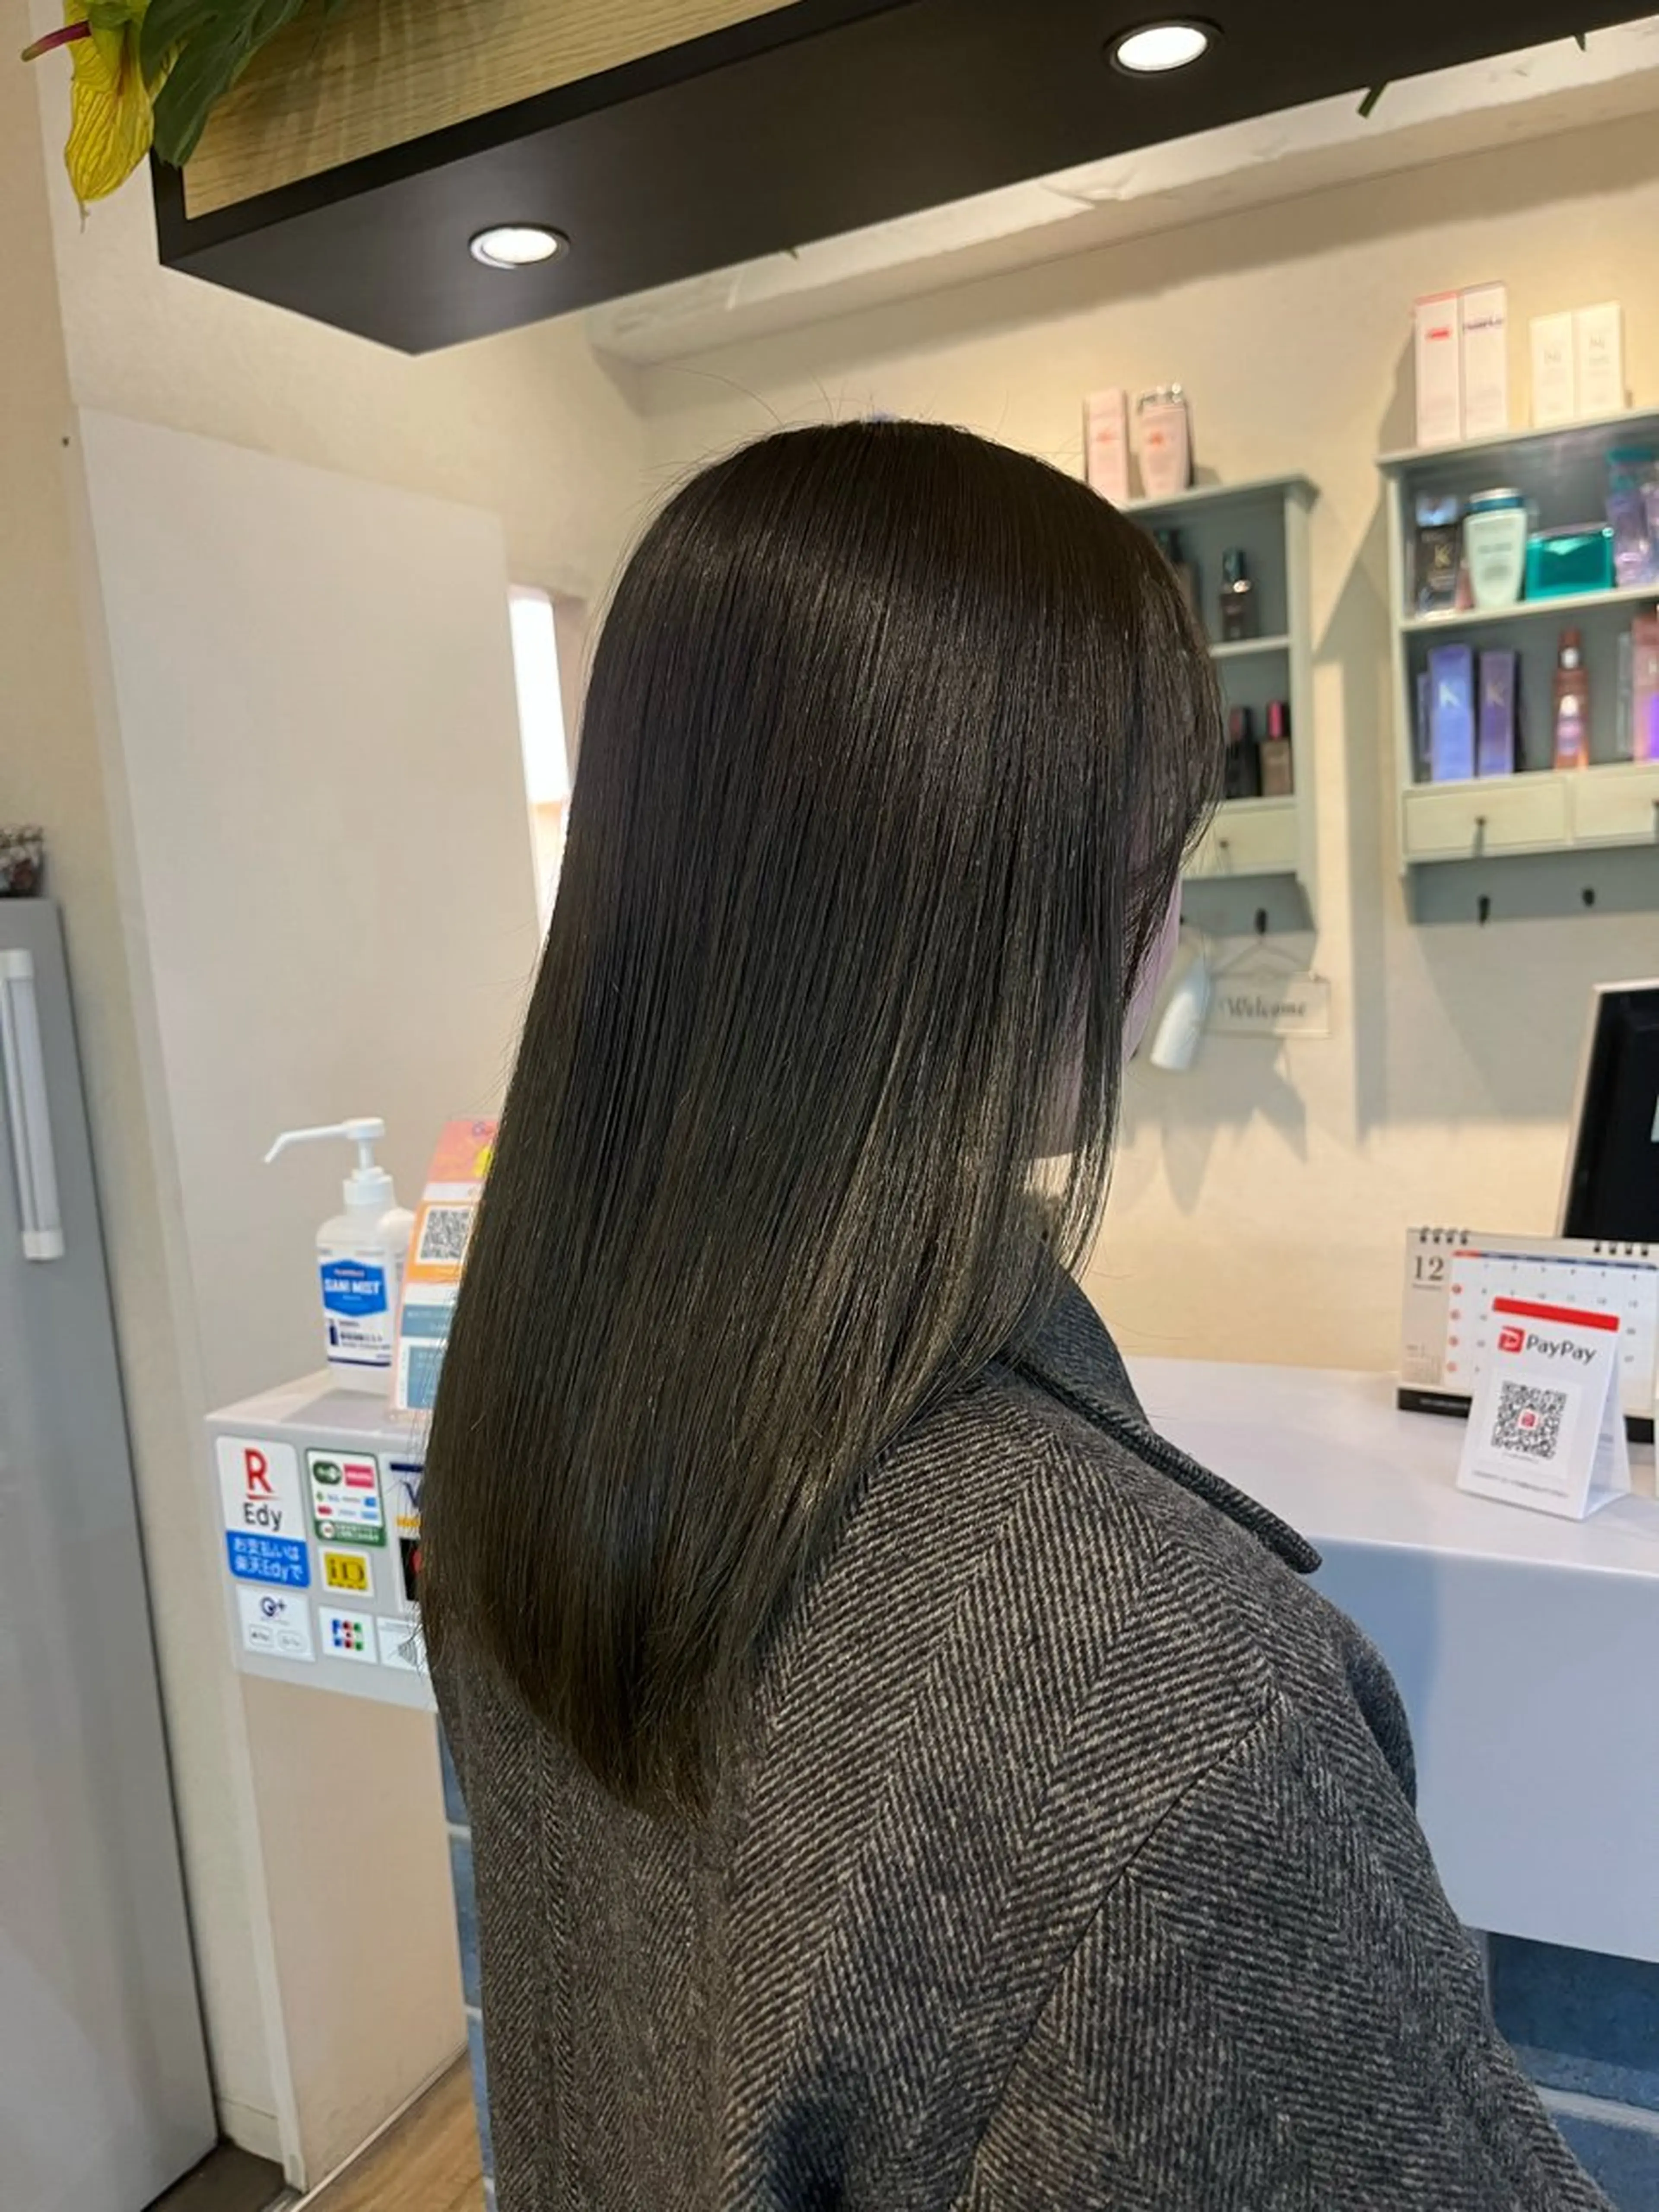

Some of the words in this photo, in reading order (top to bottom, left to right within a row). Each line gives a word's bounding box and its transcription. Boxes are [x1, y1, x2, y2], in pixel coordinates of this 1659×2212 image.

[1226, 995, 1307, 1019] Welcome
[1414, 1255, 1444, 1281] 12
[1526, 1334, 1597, 1366] PayPay
[244, 1447, 273, 1493] R
[243, 1502, 283, 1532] Edy
